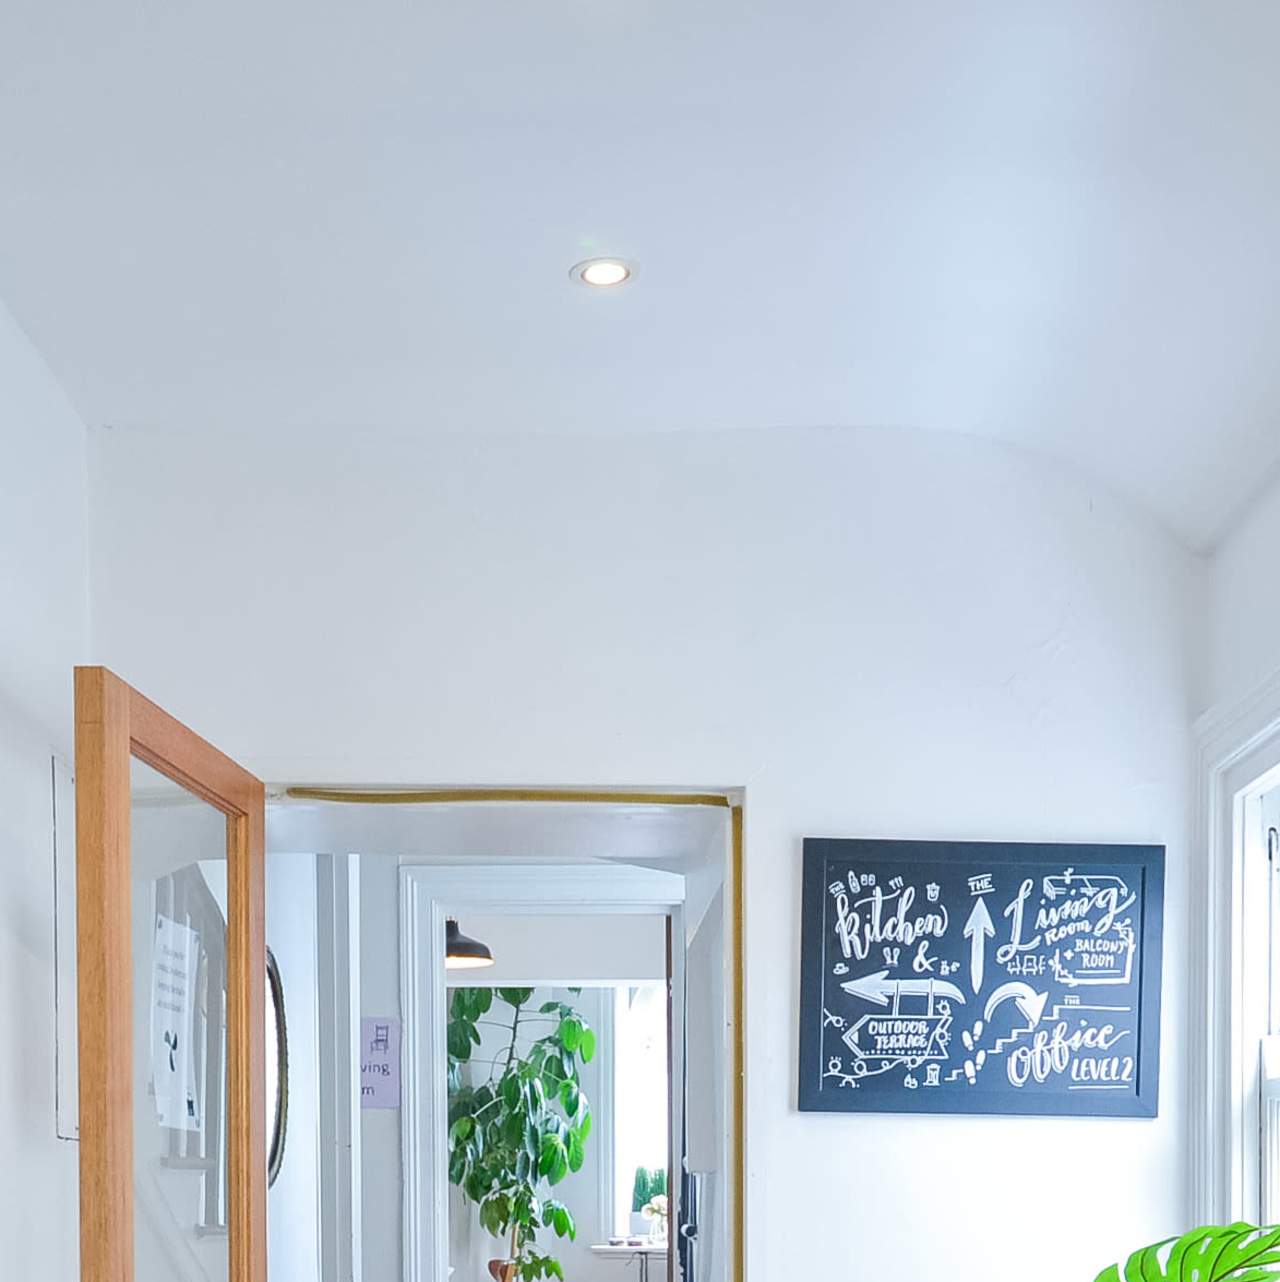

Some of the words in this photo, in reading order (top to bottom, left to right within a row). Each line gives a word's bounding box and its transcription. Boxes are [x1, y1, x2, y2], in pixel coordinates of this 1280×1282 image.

[967, 877, 993, 891] THE
[996, 879, 1136, 965] Living
[1074, 939, 1126, 954] BALCONY
[913, 940, 938, 972] &
[1082, 954, 1114, 968] ROOM
[868, 1019, 929, 1035] OUTDOOR
[1071, 1057, 1120, 1081] LEVEL
[1121, 1058, 1133, 1081] 2
